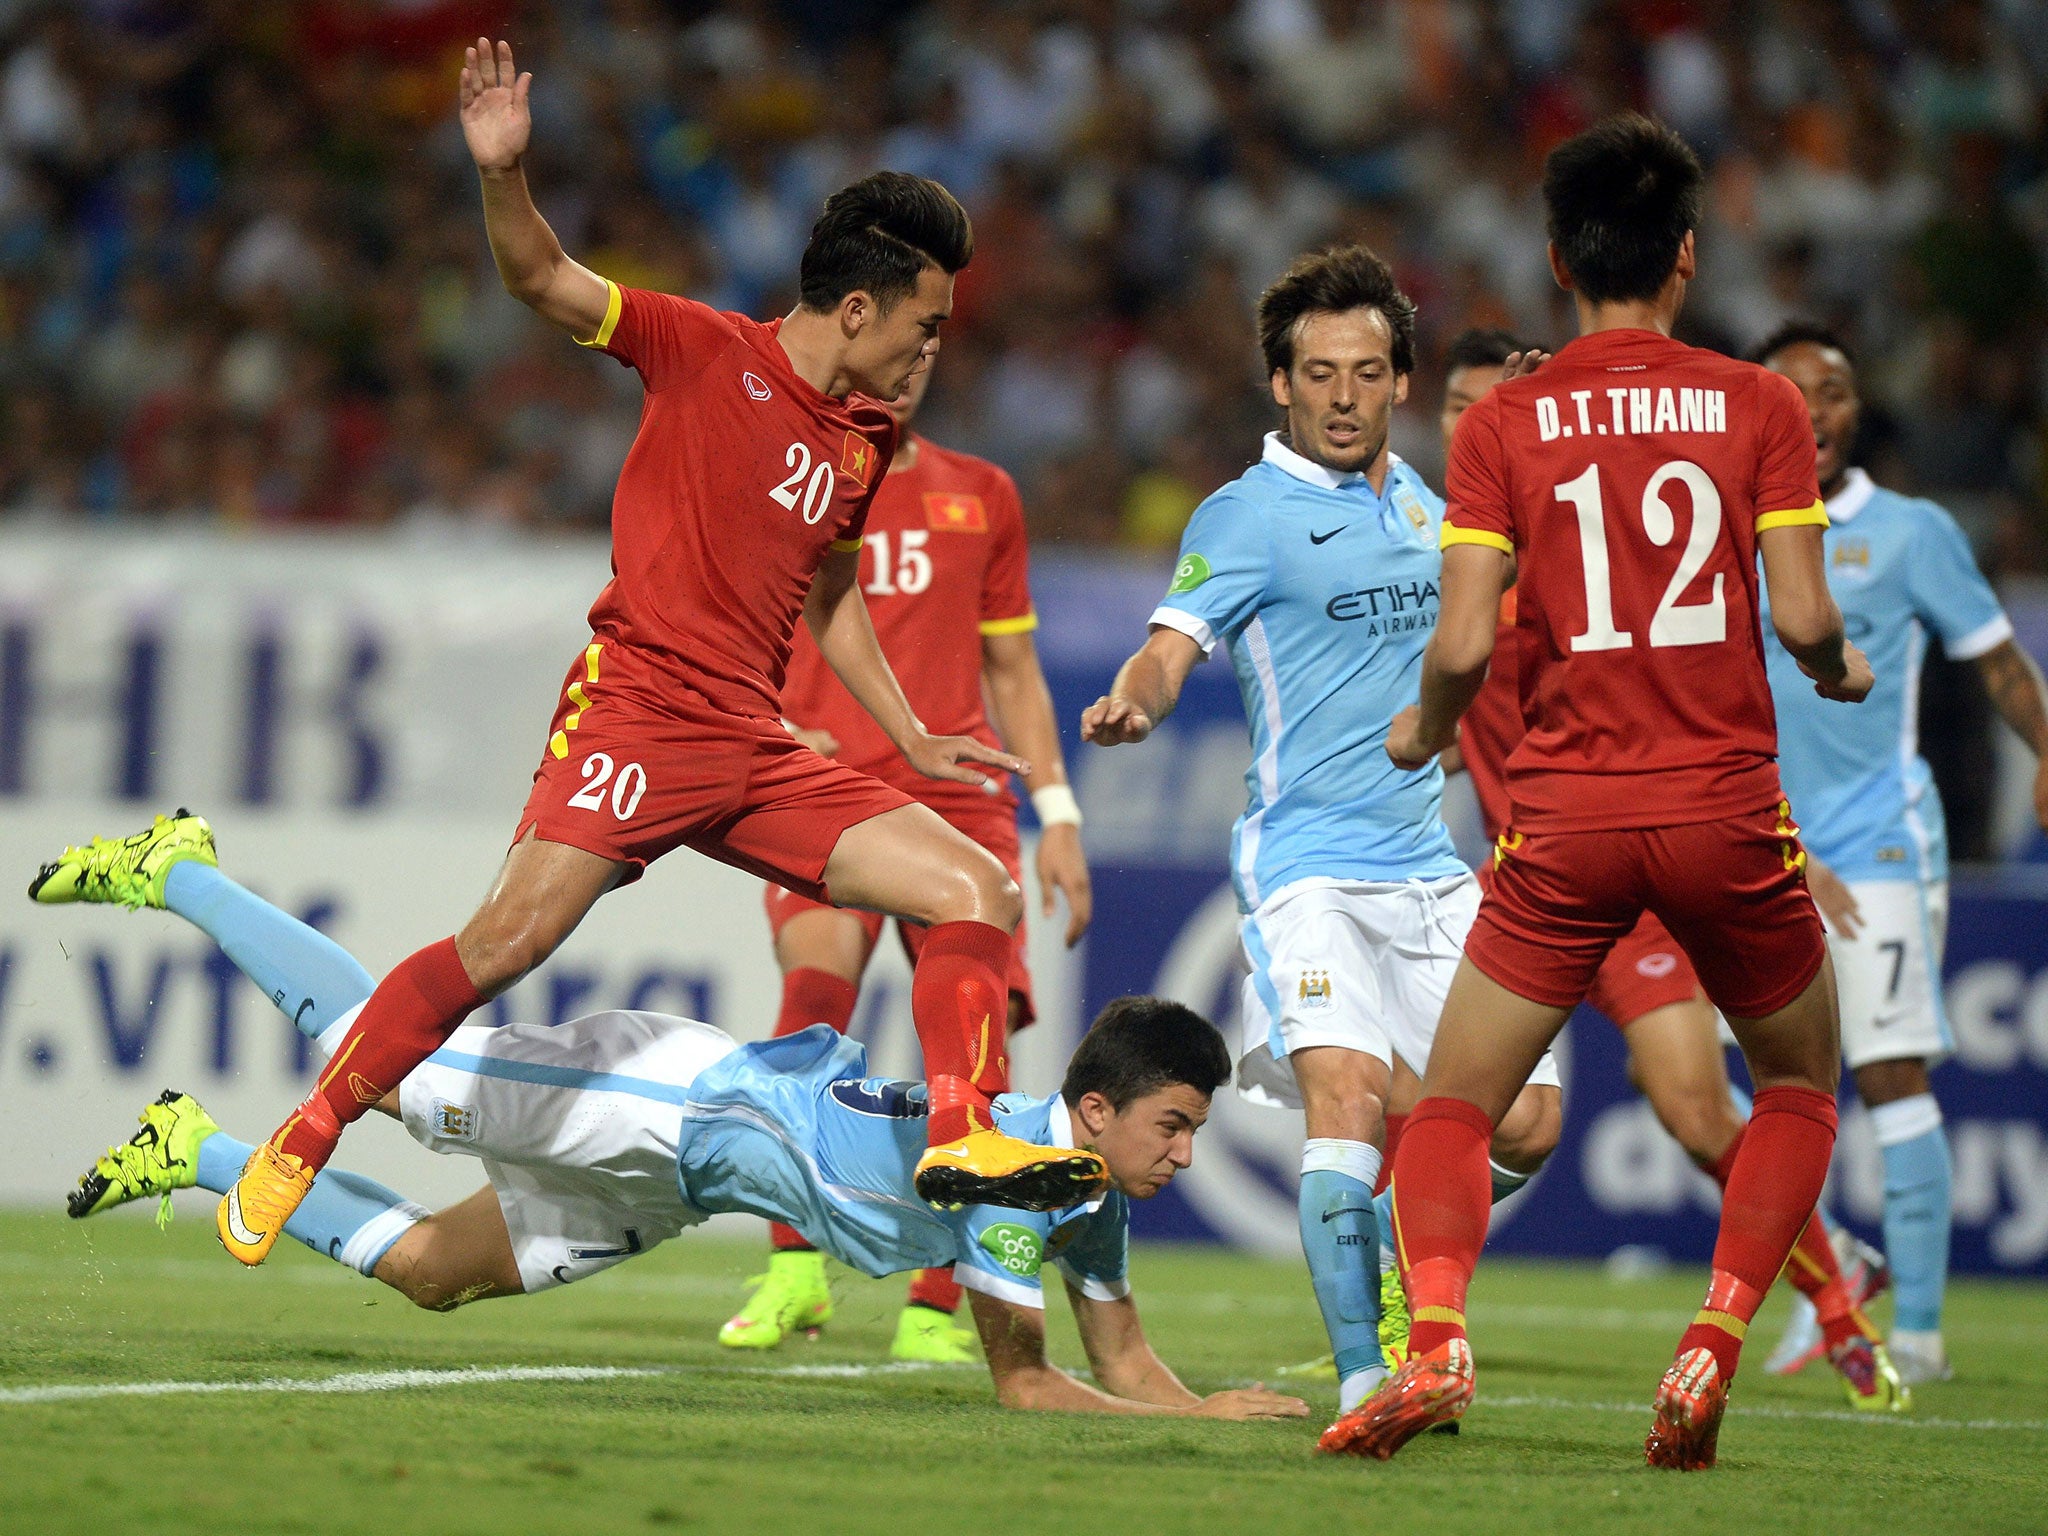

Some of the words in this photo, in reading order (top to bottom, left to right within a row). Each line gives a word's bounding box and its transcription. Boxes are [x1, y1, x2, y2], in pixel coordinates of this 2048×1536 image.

[1536, 387, 1726, 441] D.T.THANH
[769, 442, 834, 525] 20
[865, 529, 932, 596] 15
[1555, 460, 1727, 652] 12
[1326, 577, 1440, 621] ETIHA
[1367, 612, 1438, 638] AIRWAY
[567, 752, 647, 821] 20
[1877, 940, 1905, 996] 7
[1000, 1255, 1031, 1272] JOY
[1336, 1234, 1371, 1246] CITY
